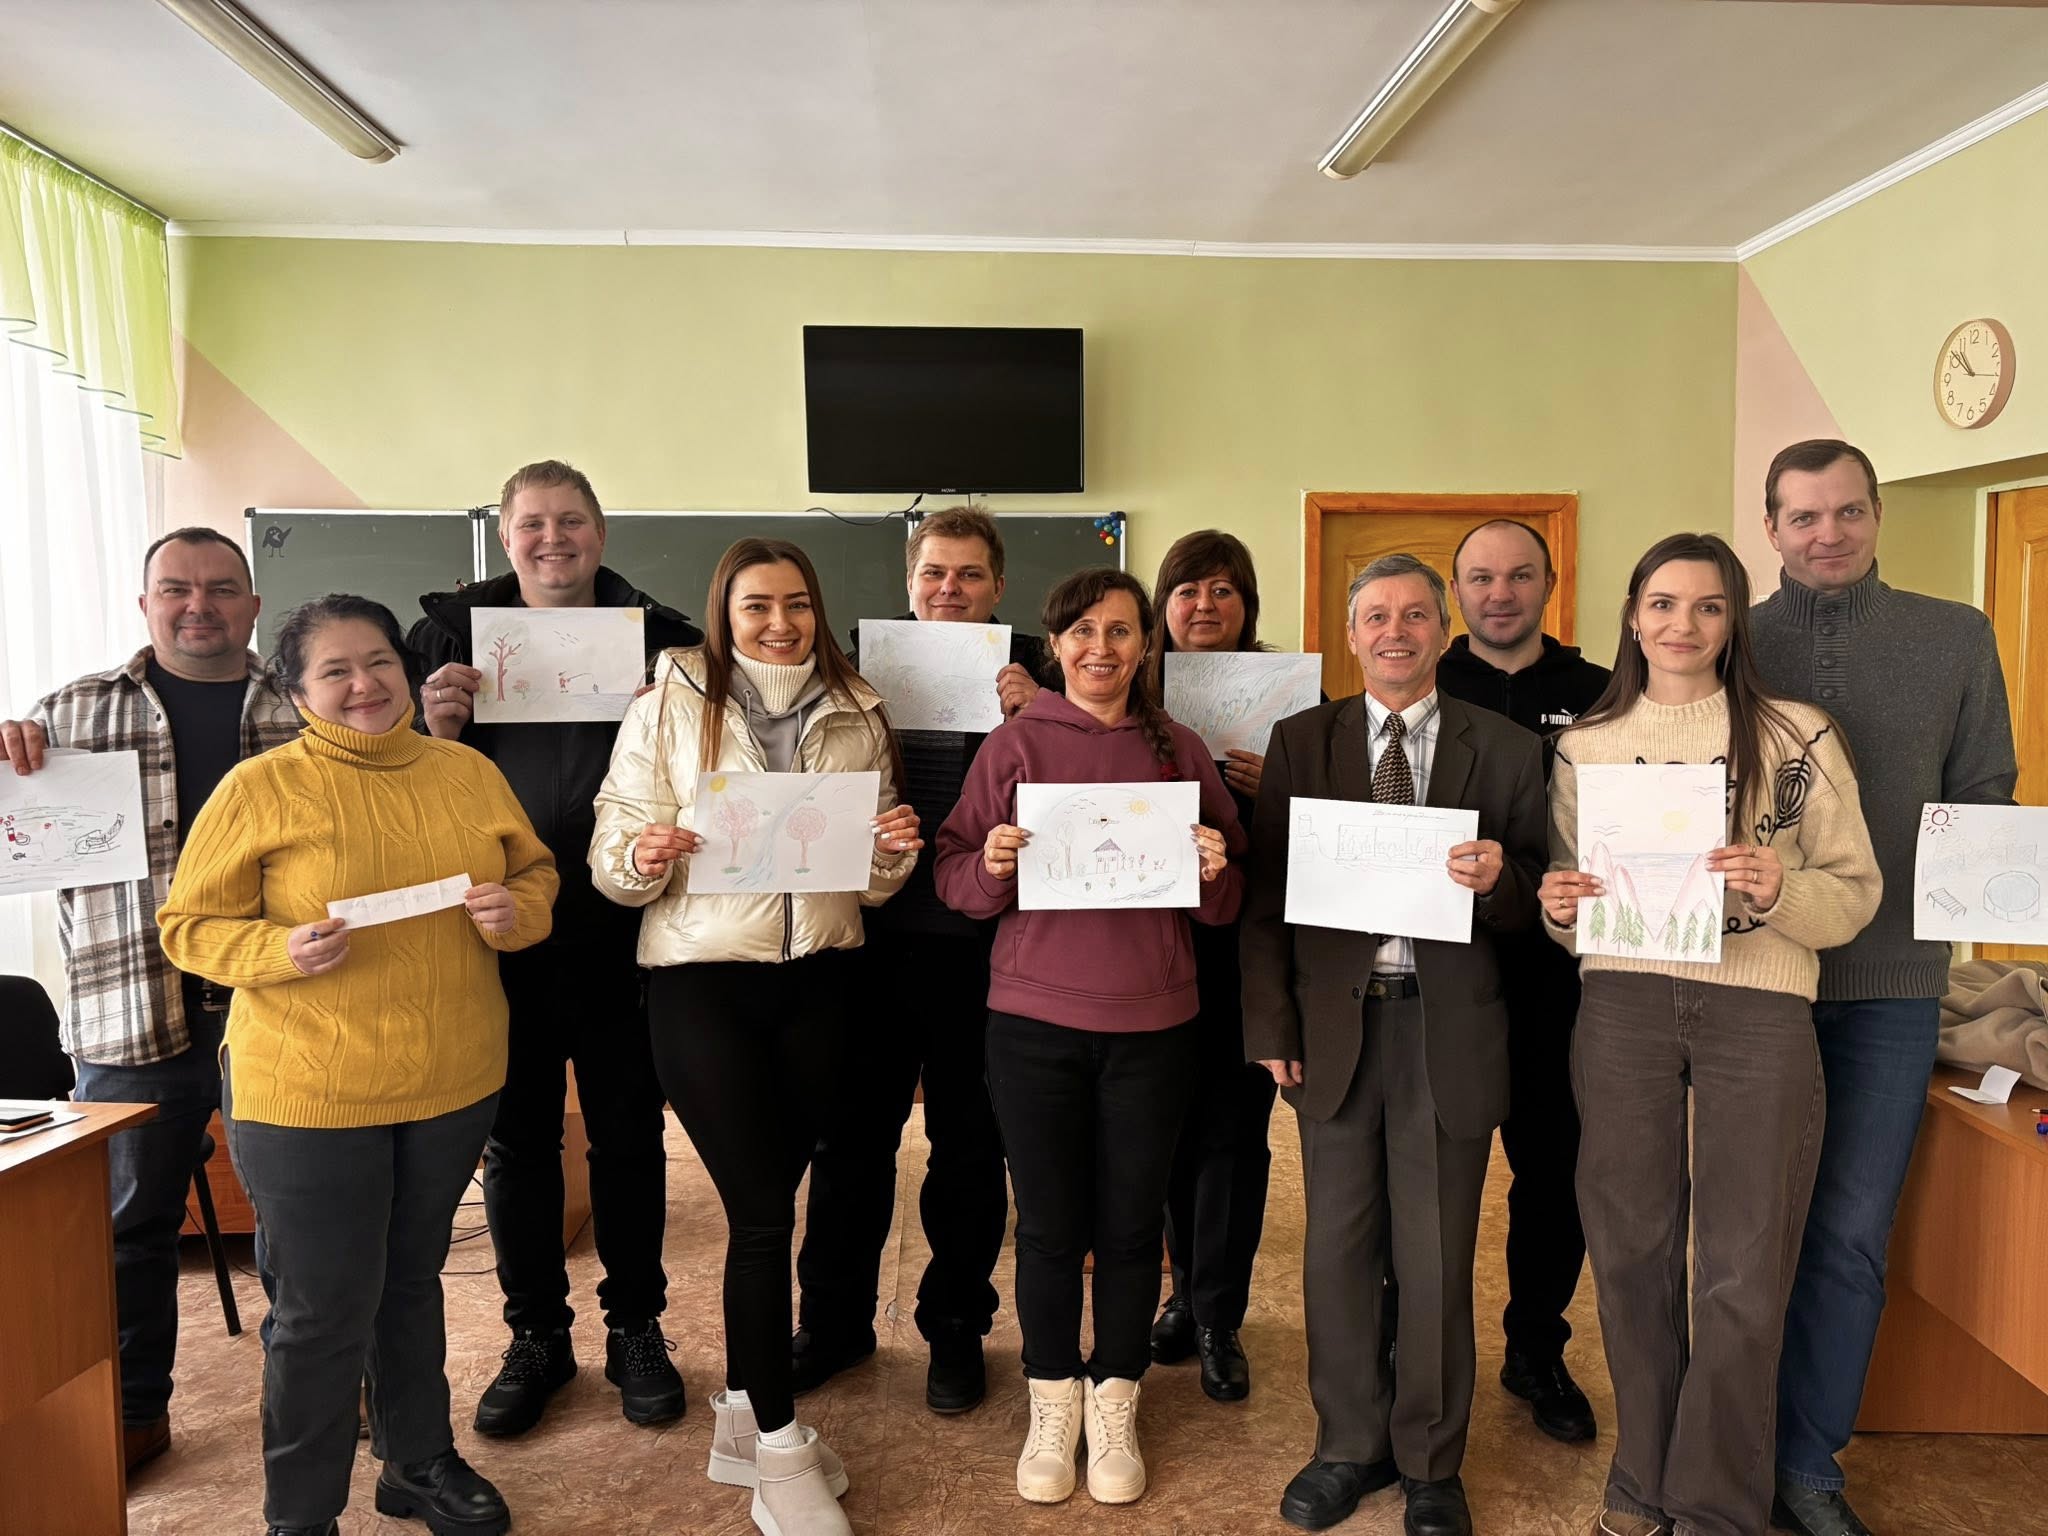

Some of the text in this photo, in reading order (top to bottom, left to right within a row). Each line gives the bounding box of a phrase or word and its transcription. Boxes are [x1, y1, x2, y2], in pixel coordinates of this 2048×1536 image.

[1969, 329, 1980, 344] 12
[1991, 342, 1999, 358] 2
[1944, 373, 1951, 387] 9
[1947, 390, 1954, 406] 8
[1979, 397, 1987, 413] 5
[1957, 402, 1964, 417] 7
[1967, 406, 1974, 420] 6
[1541, 714, 1573, 725] PUMA
